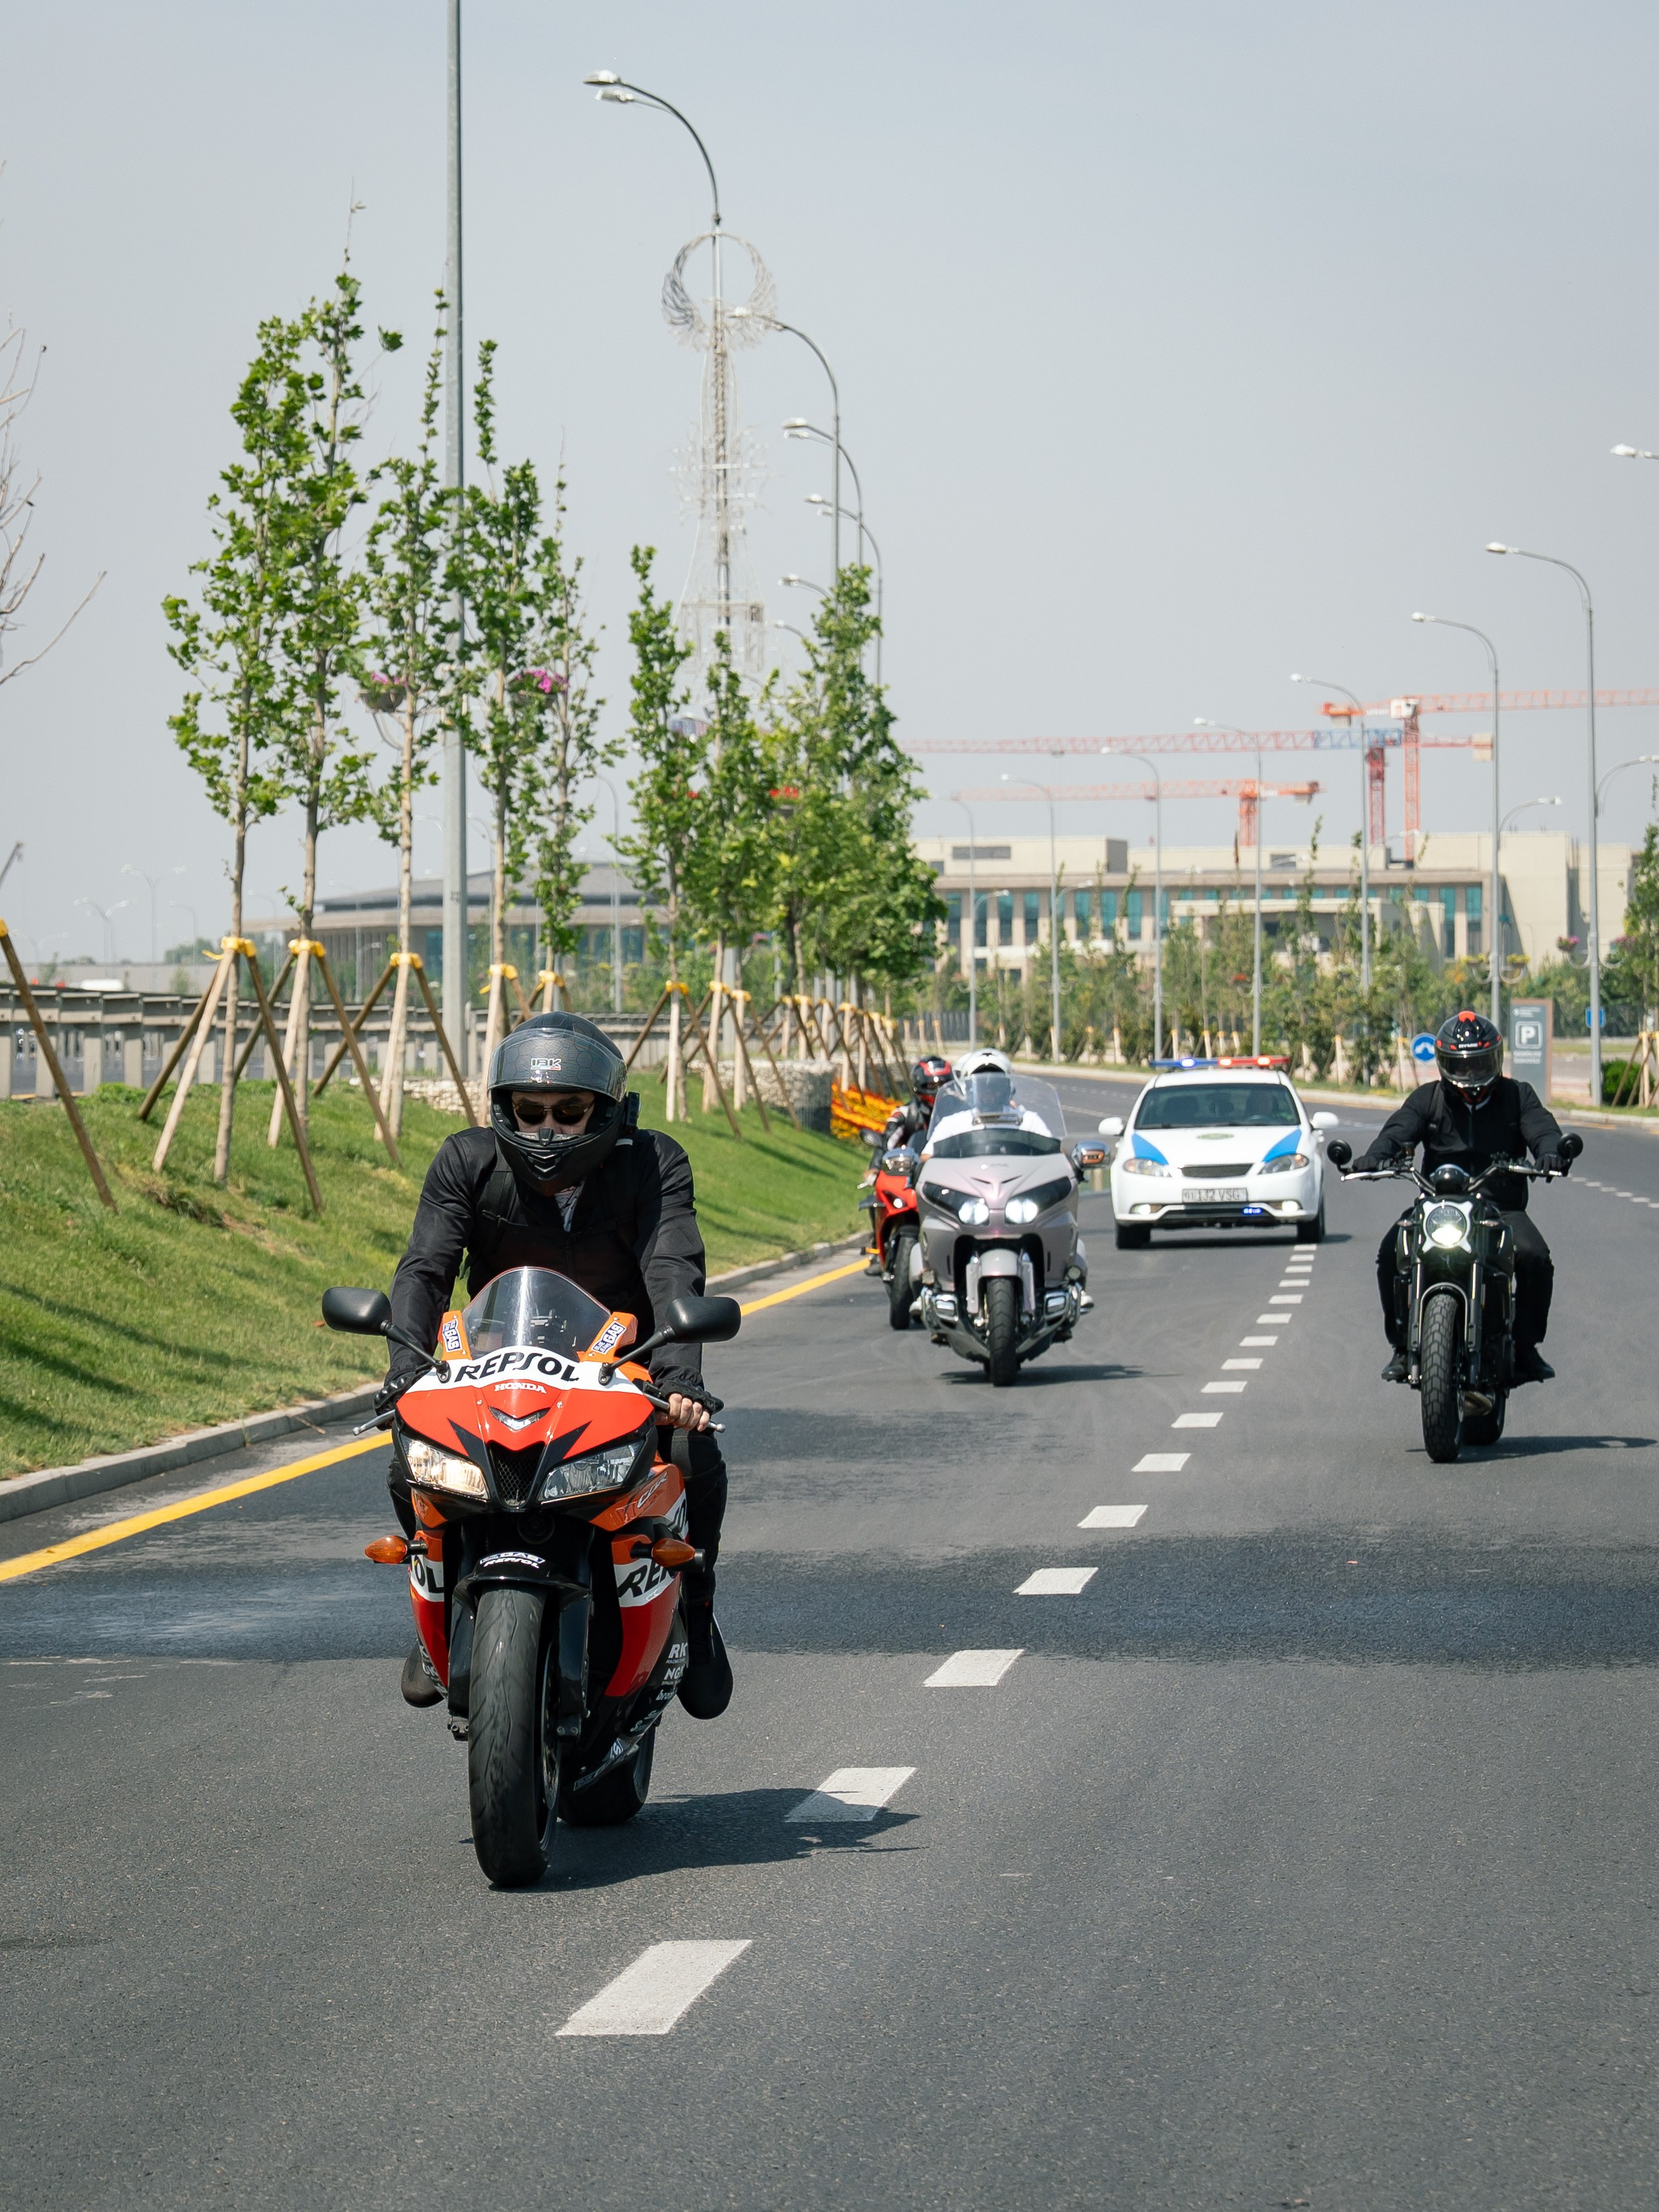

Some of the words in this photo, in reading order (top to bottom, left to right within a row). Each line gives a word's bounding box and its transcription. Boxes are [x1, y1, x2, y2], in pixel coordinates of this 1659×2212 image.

[1521, 1026, 1535, 1044] P
[602, 1323, 624, 1344] GAS
[454, 1352, 579, 1383] REPSOL
[494, 1382, 547, 1394] HONDA
[668, 1642, 688, 1658] RK
